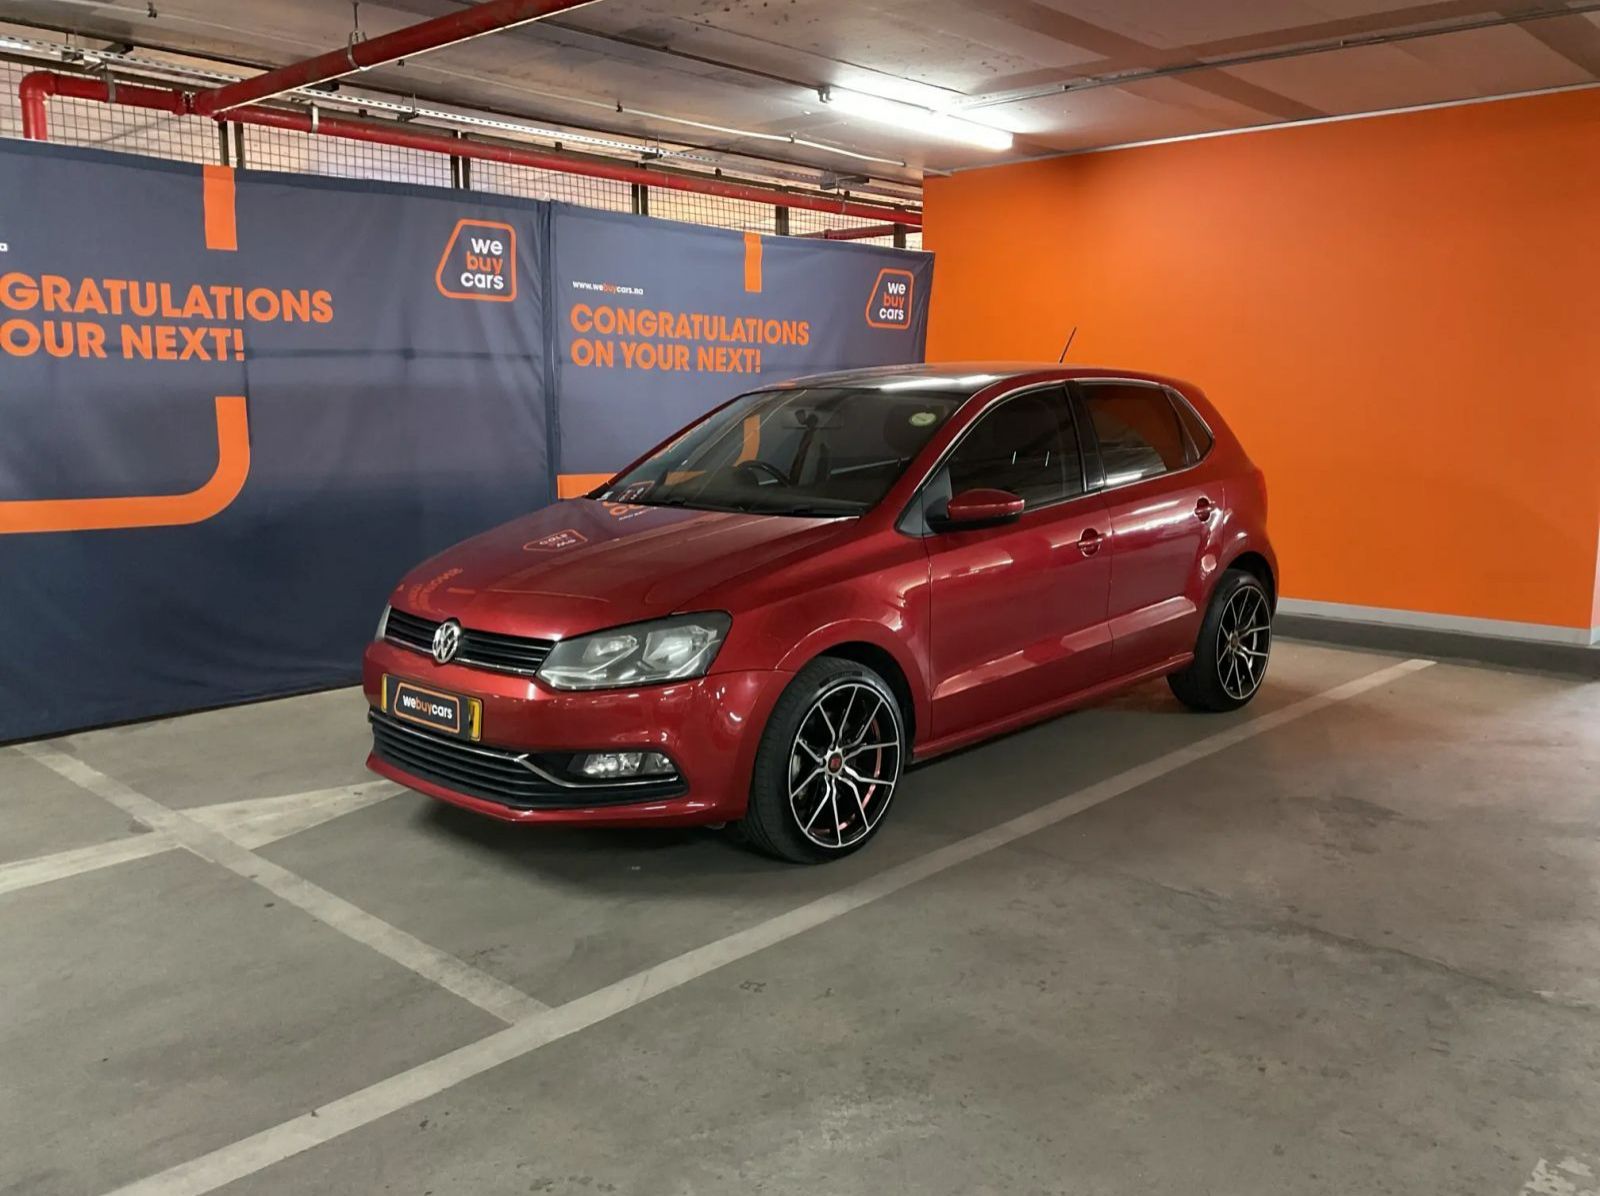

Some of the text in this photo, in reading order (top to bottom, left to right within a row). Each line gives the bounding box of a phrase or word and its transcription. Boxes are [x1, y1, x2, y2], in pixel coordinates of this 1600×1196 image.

[471, 237, 503, 256] we
[466, 250, 503, 276] buy
[460, 272, 504, 290] cars
[887, 281, 906, 295] we
[0, 271, 334, 324] GRATULATIONS
[883, 291, 905, 309] buy
[570, 303, 810, 346] CONGRATULATIONS
[879, 307, 904, 321] cars
[0, 318, 245, 362] OUR NEXT!
[570, 338, 761, 374] ON YOUR NEXT!
[402, 694, 453, 720] webuycars
